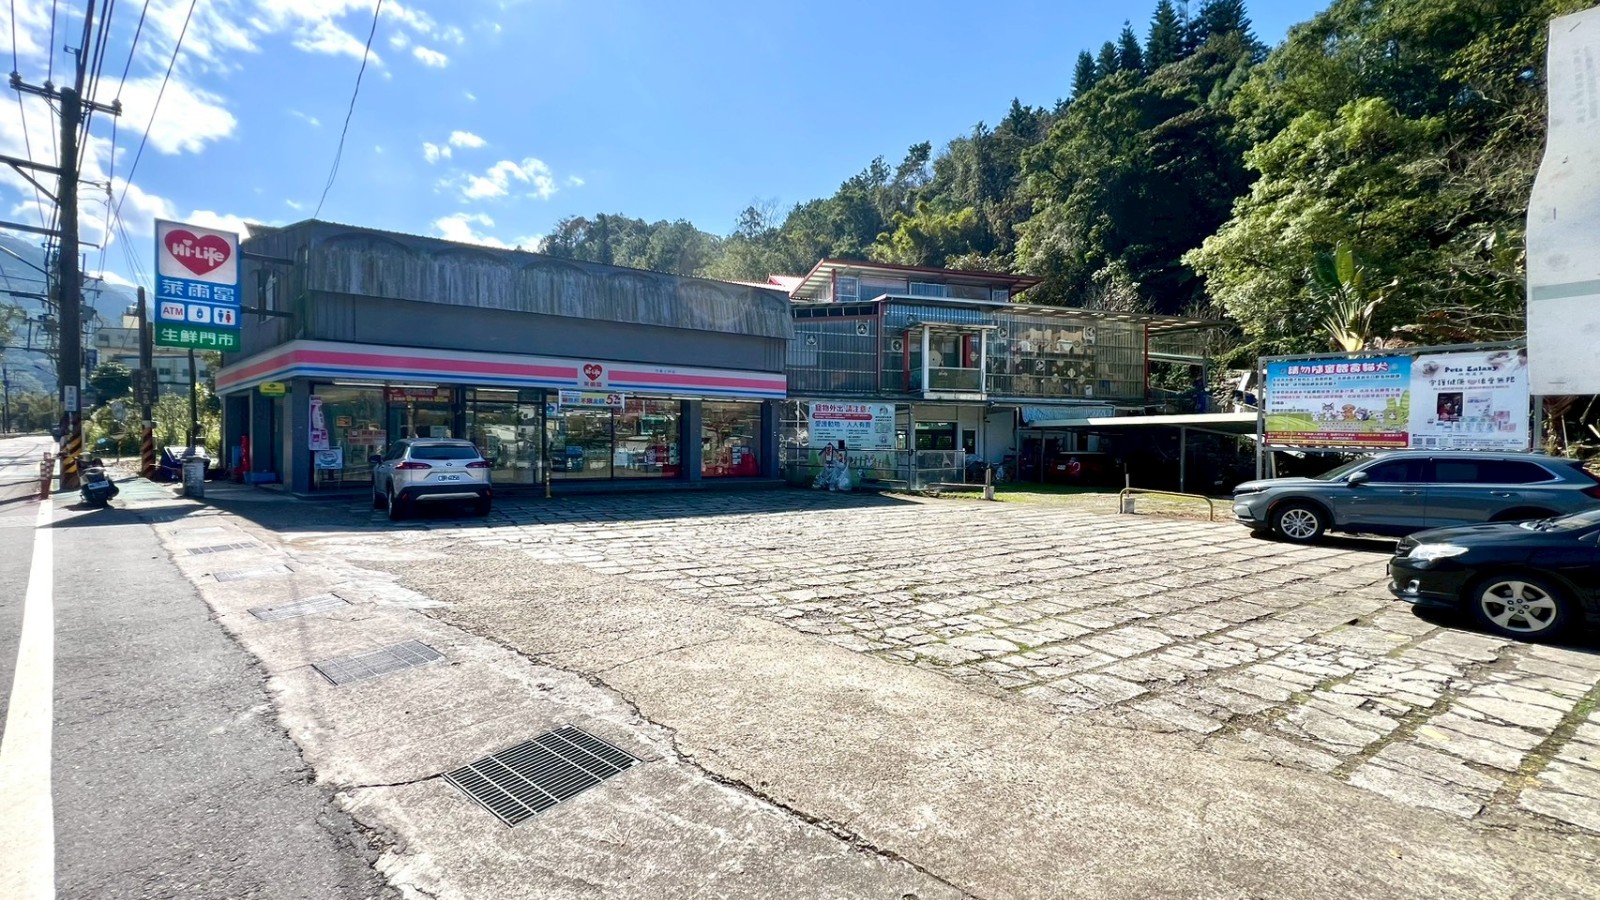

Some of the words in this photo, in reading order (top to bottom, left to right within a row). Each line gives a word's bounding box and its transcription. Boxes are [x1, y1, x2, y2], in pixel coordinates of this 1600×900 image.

[172, 239, 225, 267] Hi-Life
[162, 280, 234, 301] 萊爾富
[162, 306, 183, 316] ATM
[161, 328, 234, 346] 生鮮門市
